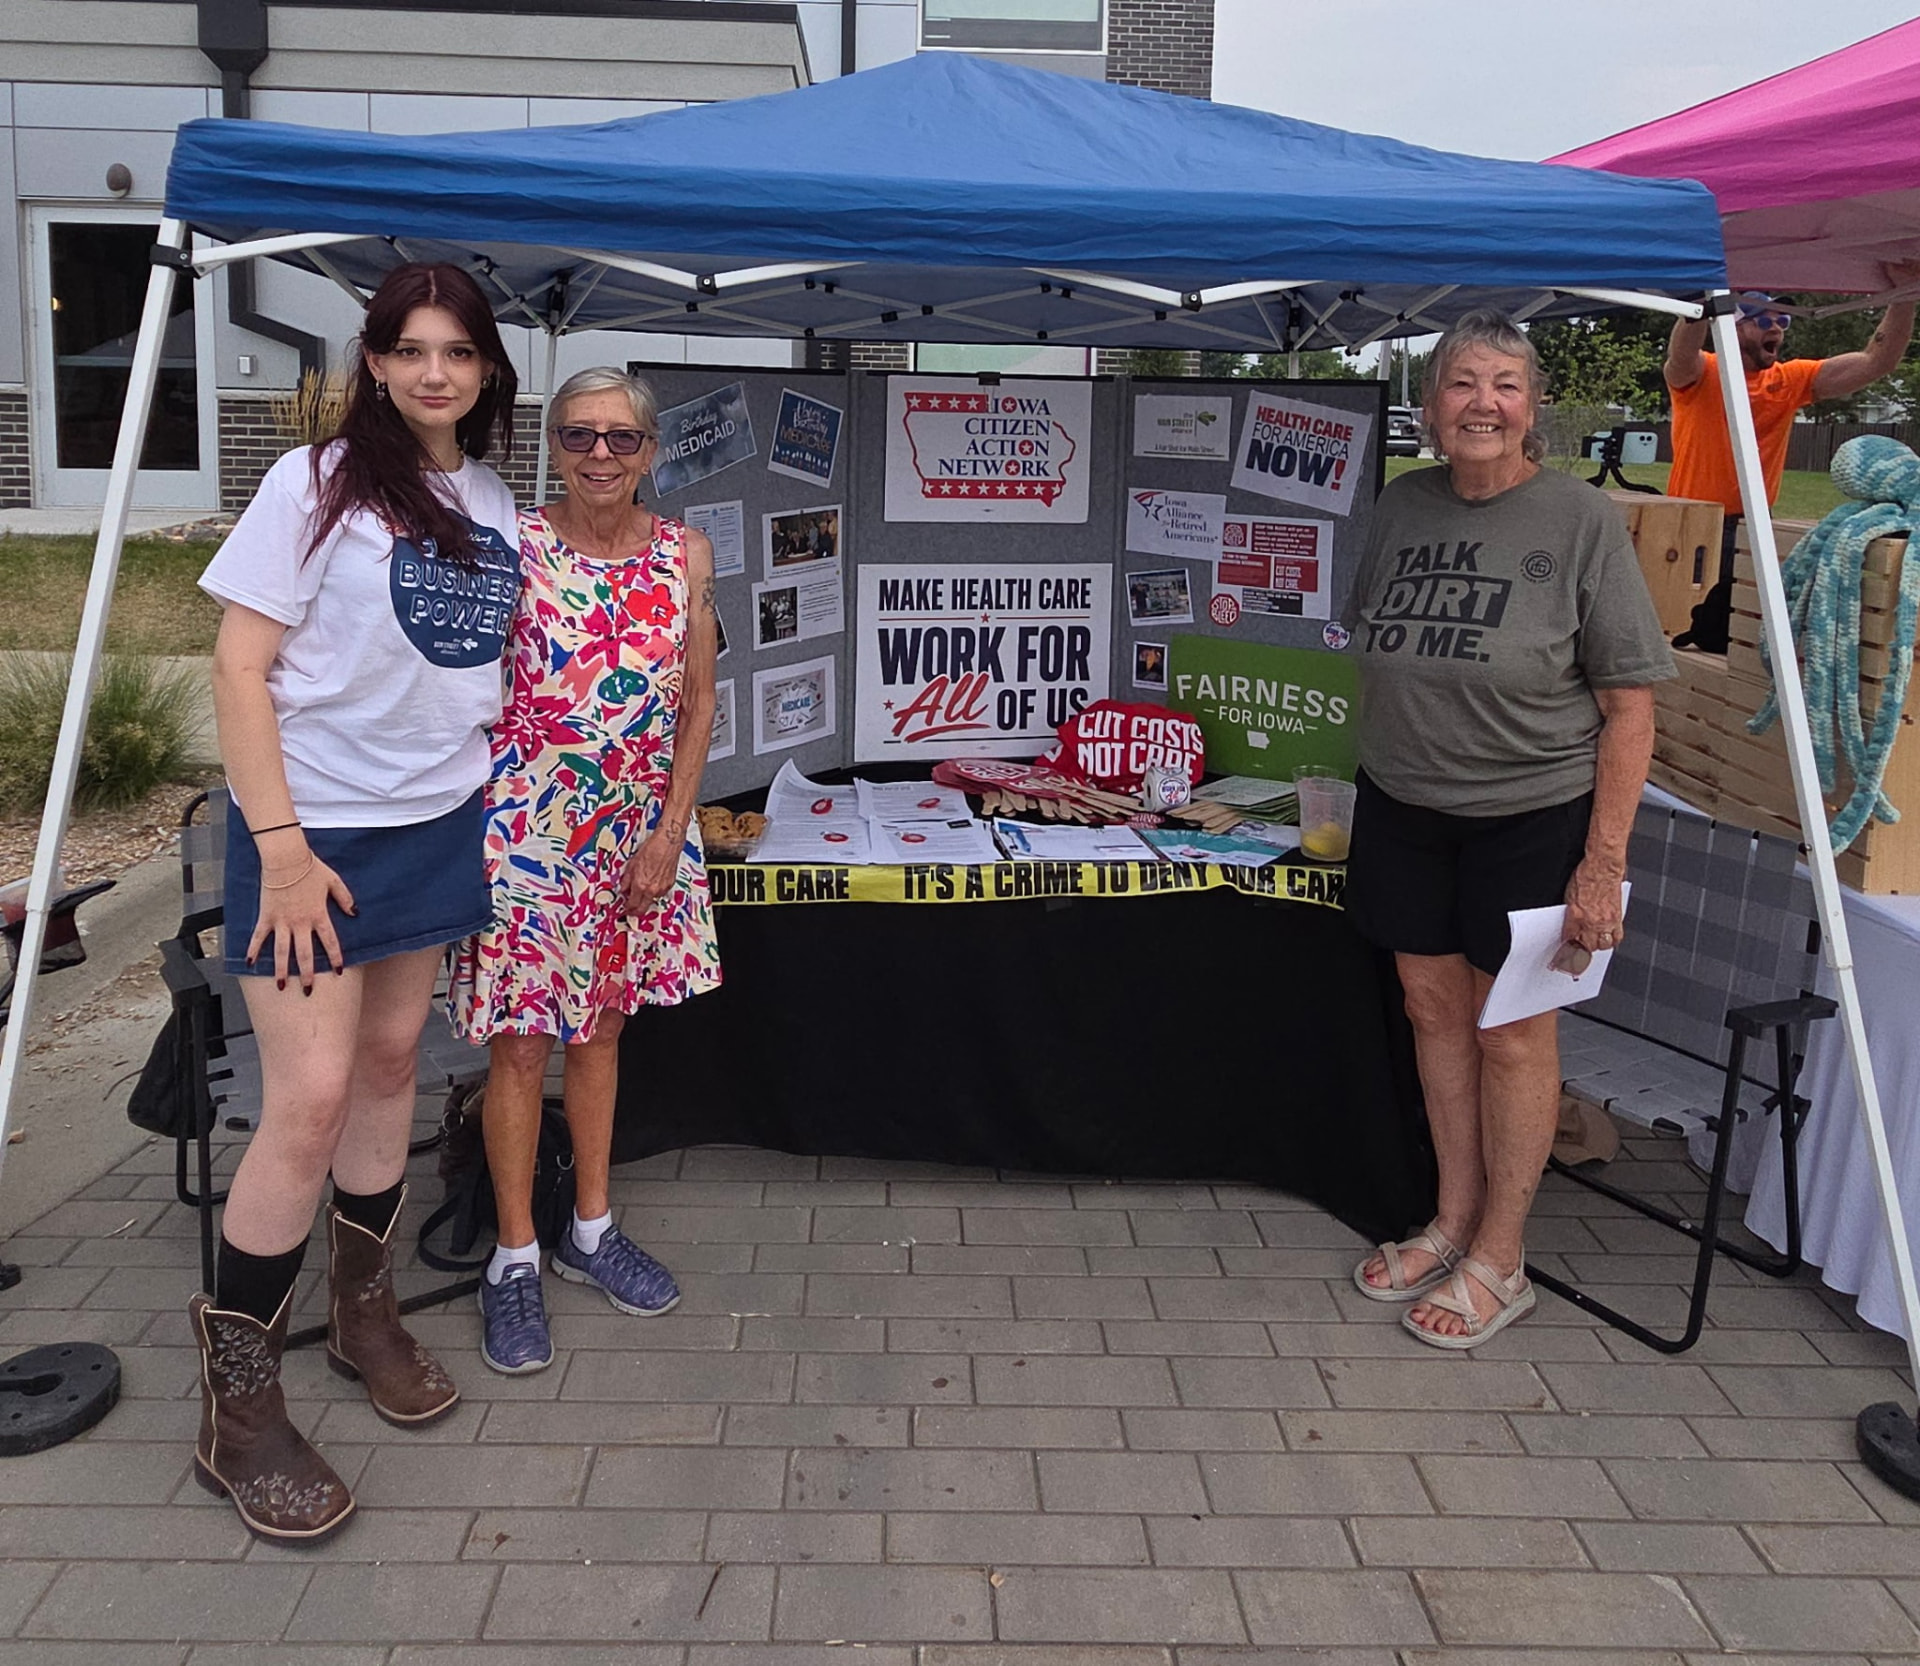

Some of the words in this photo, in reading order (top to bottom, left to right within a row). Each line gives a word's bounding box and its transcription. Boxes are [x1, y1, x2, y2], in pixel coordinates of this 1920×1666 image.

[665, 420, 735, 462] MEDICAID
[965, 418, 1050, 437] CITIZEN
[1252, 422, 1281, 443] FOR
[1283, 430, 1349, 460] AMERICA
[1256, 406, 1312, 433] HEALTH
[1312, 417, 1354, 442] CARE
[966, 438, 1050, 456] ACTION
[1245, 438, 1347, 491] NOW!
[938, 459, 1050, 476] NETWORK
[1163, 507, 1203, 520] Alliance
[1165, 495, 1187, 507] Iowa
[1171, 519, 1207, 532] Retired
[1397, 541, 1484, 577] TALK
[879, 578, 944, 611] MAKE
[951, 578, 1032, 610] HEALTH
[1038, 578, 1092, 609] CARE
[1380, 578, 1503, 620] DIRT
[409, 594, 511, 636] POWER
[878, 626, 1006, 685] WORK
[1017, 625, 1092, 683] FOR
[1366, 624, 1407, 653] TO
[1415, 626, 1491, 663] ME.
[891, 672, 989, 736] All
[997, 689, 1037, 730] OF
[1176, 674, 1349, 725] FAIRNESS
[1077, 710, 1126, 739] CUT
[1130, 716, 1204, 754] COSTS
[1218, 705, 1253, 727] FOR
[1258, 712, 1305, 735] IOWA
[1077, 742, 1125, 777] NOT
[707, 868, 766, 902] OUR
[776, 868, 849, 902] CARE
[904, 864, 954, 900] IT'S
[965, 864, 985, 899] A
[994, 862, 1083, 898] CRIME
[1093, 862, 1129, 894] TO
[1140, 862, 1208, 892] DENY
[1219, 863, 1276, 895] OUR
